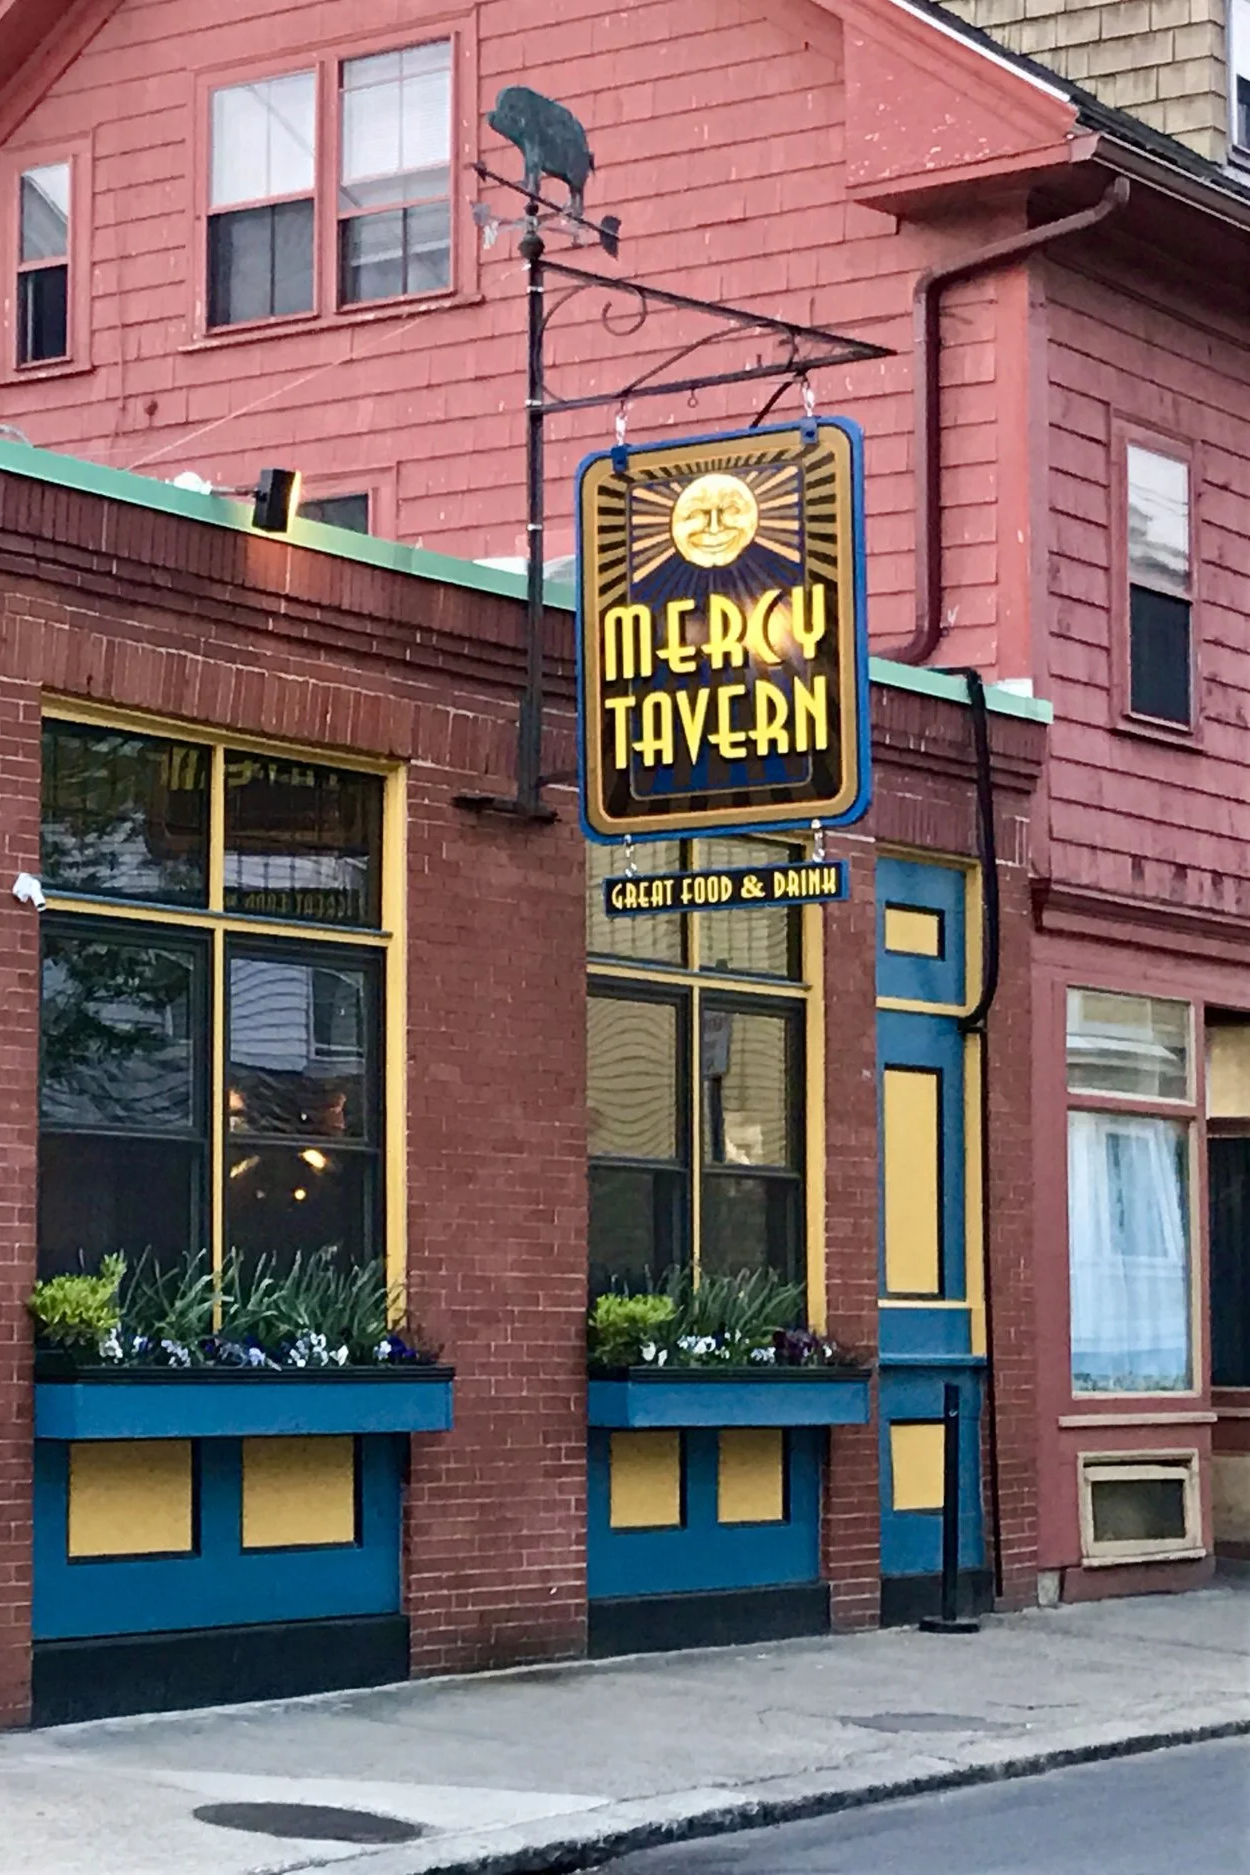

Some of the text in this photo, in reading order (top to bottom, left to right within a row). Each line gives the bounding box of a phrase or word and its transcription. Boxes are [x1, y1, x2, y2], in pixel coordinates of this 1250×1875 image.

[604, 583, 825, 681] MERCY
[605, 675, 827, 769] TAVERN
[612, 867, 836, 909] GREAT FOOD & DRINK
